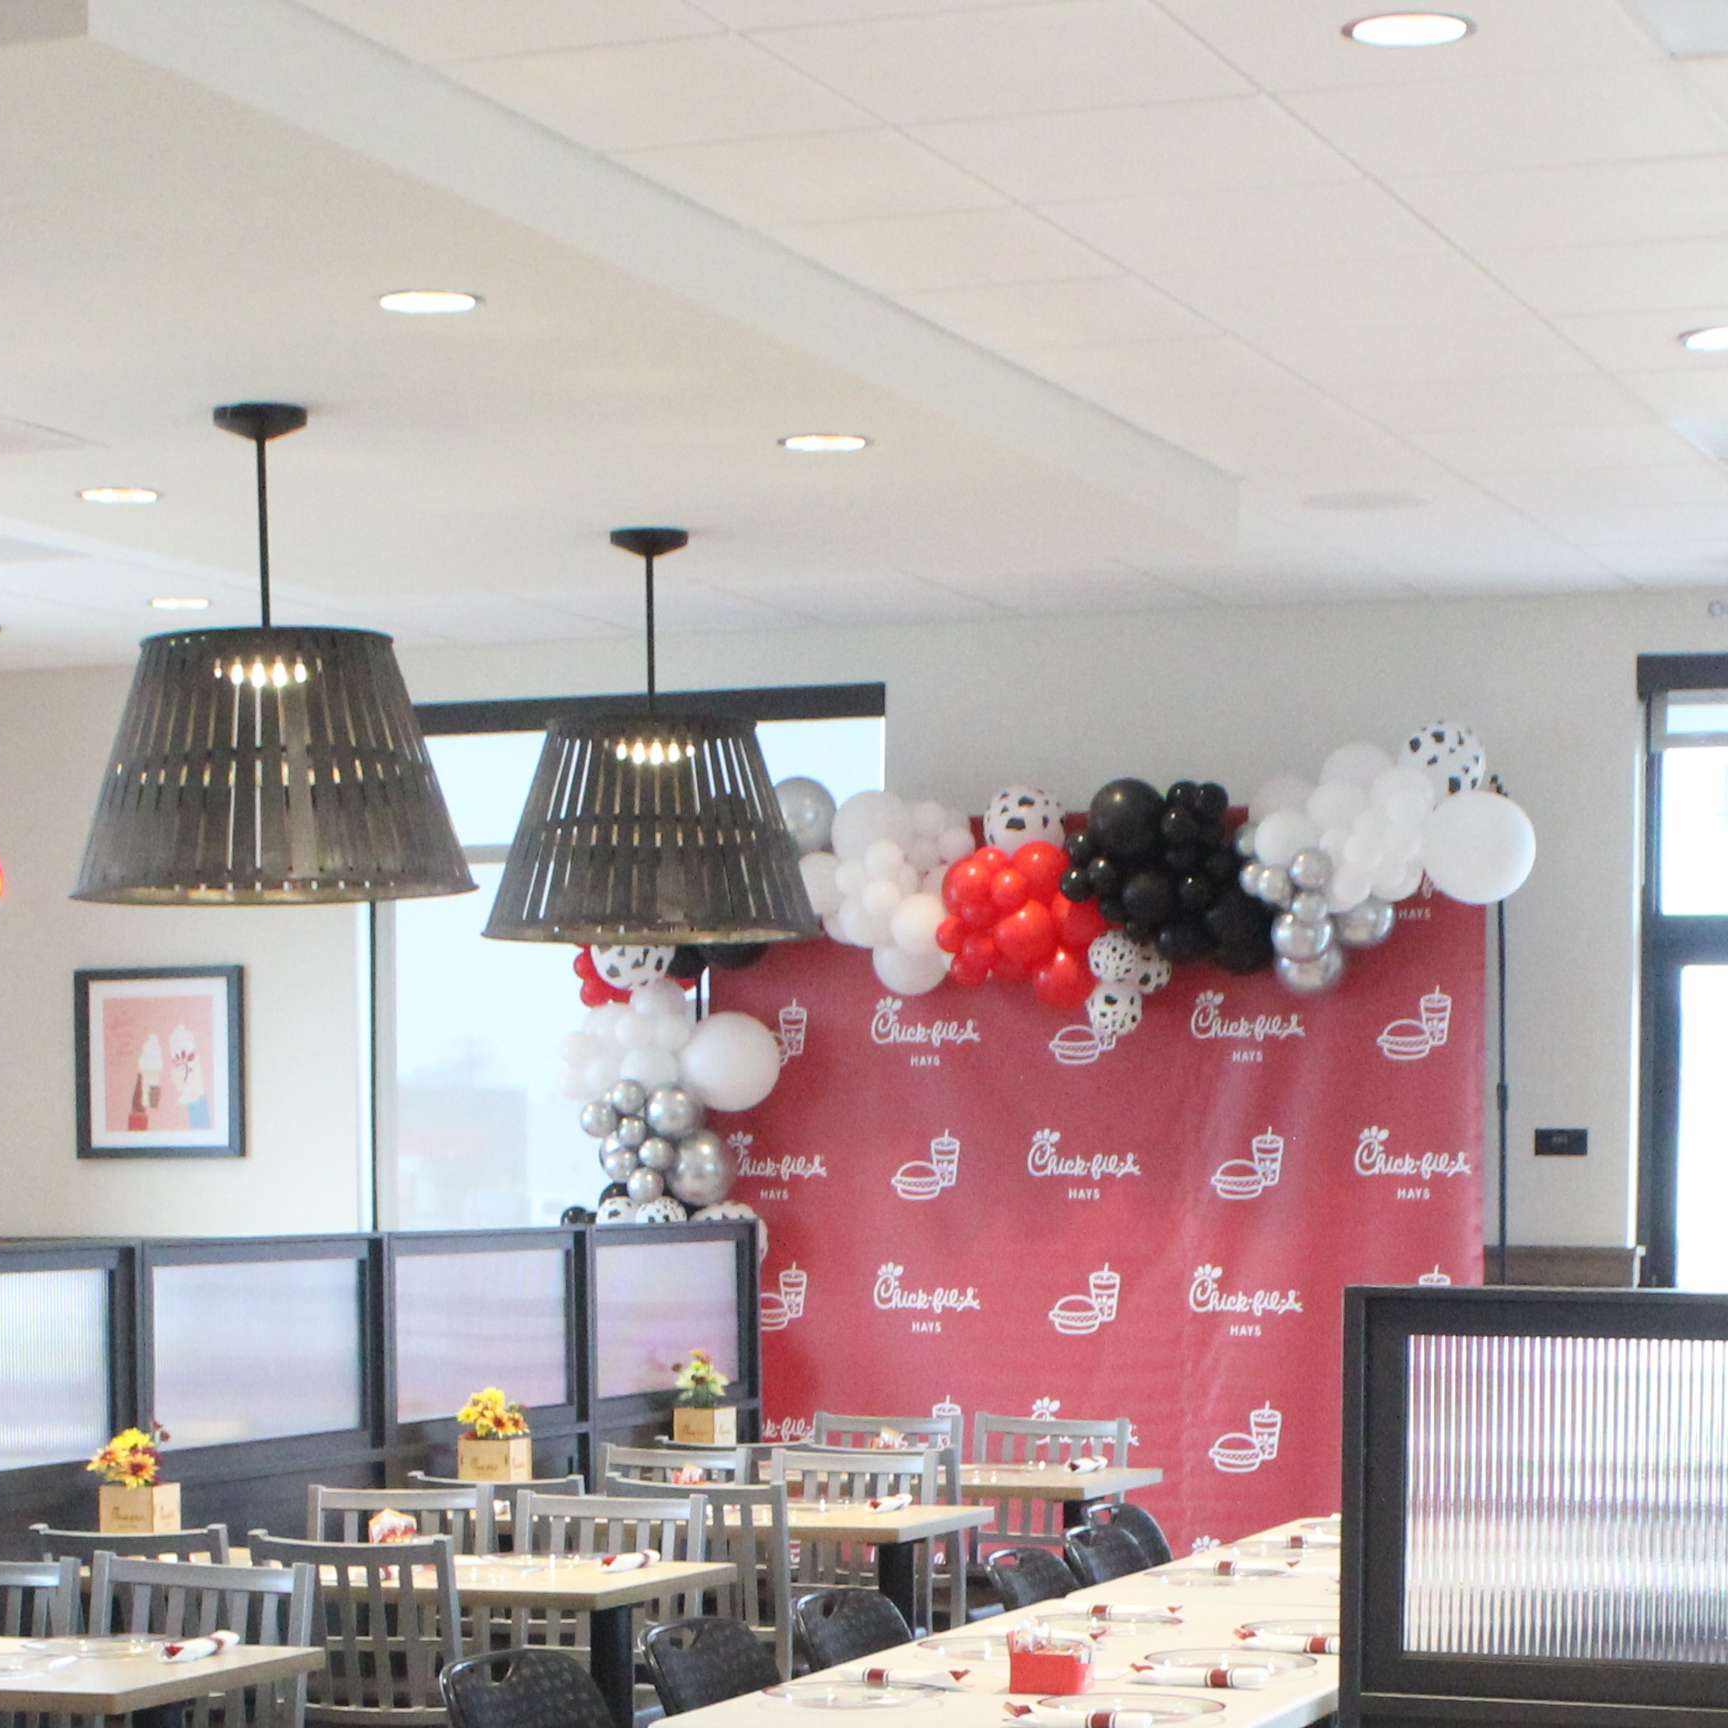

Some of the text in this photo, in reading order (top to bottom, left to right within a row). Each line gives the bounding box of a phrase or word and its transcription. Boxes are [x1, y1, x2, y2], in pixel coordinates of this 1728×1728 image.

[1399, 907, 1431, 919] HAYS
[910, 1055, 940, 1067] HAYS
[1232, 1050, 1263, 1062] HAYS
[760, 1189, 789, 1200] HAYS
[1068, 1188, 1100, 1200] HAYS
[1397, 1188, 1430, 1200] HAYS
[912, 1321, 942, 1333] HAYS
[1229, 1325, 1262, 1337] HAYS
